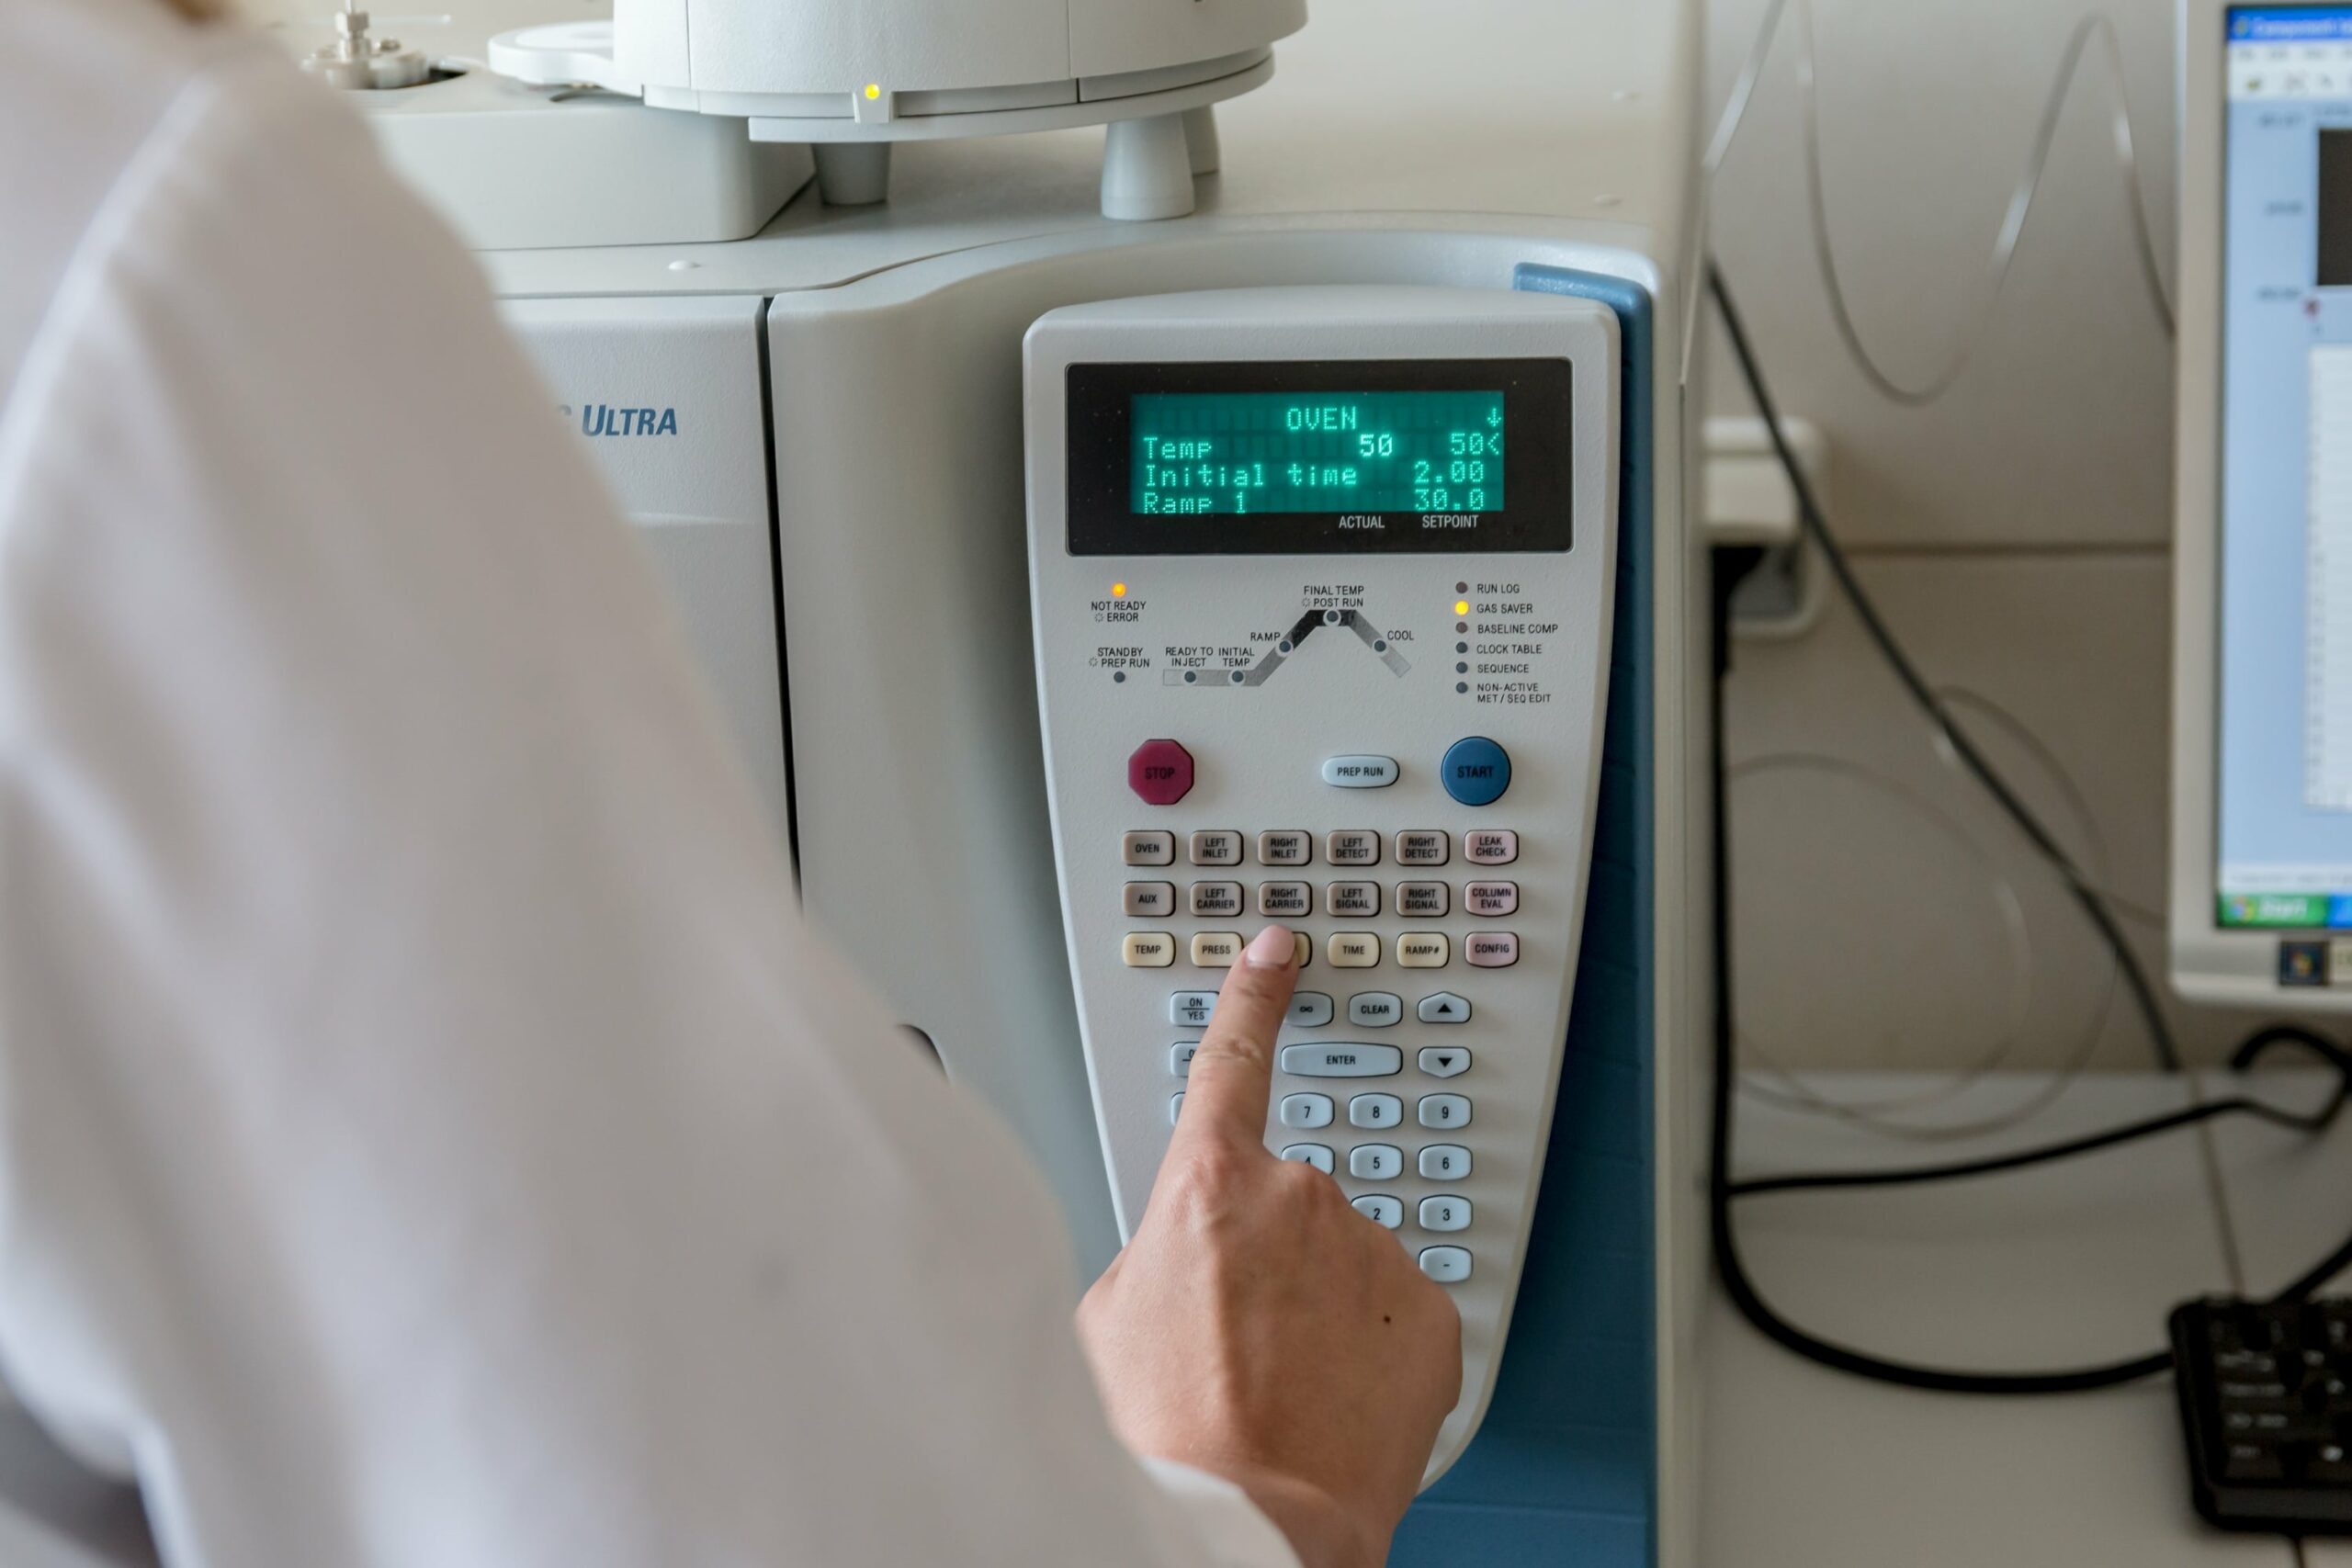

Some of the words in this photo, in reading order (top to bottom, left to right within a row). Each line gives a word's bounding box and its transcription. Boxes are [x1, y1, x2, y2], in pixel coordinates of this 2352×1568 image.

[1287, 407, 1356, 430] OVEN
[1143, 436, 1212, 459] Temp
[1361, 434, 1392, 457] 50
[1146, 464, 1263, 487] Initial
[1287, 463, 1357, 487] time
[1415, 460, 1483, 483] 2.00
[1144, 491, 1212, 513] Ramp
[1237, 491, 1246, 513] 1
[1415, 489, 1483, 511] 30.0
[1339, 515, 1385, 528] ACTUAL
[1422, 514, 1478, 528] SETPOINT
[1304, 586, 1333, 595] FINAL
[1336, 586, 1364, 595] TEMP
[1477, 584, 1498, 593] RUN
[1501, 584, 1520, 593] LOG
[1091, 602, 1111, 611] NOT
[1114, 601, 1147, 610] READY
[1314, 599, 1339, 607] POST
[1342, 598, 1363, 606] RUN
[1477, 604, 1498, 614] GAS
[1501, 604, 1533, 614] SAVER
[1107, 613, 1139, 622] ERROR
[1477, 625, 1525, 634] BASELINE
[1528, 625, 1558, 634] COMP
[1250, 632, 1281, 641] RAMP
[1387, 630, 1414, 640] COOL
[1098, 647, 1144, 657] STANDBY
[1165, 647, 1198, 656] READY
[1201, 647, 1214, 656] TO
[1218, 647, 1255, 656] INITIAL
[1476, 644, 1509, 654] CLOCK
[1511, 644, 1542, 654] TABLE
[1102, 658, 1126, 668] PREP
[1129, 658, 1150, 668] RUN
[1171, 658, 1206, 667] INJECT
[1223, 658, 1250, 667] TEMP
[1477, 663, 1529, 673] SEQUENCE
[1477, 683, 1538, 692] NON-ACTIVE
[1477, 694, 1498, 704] MET
[1507, 694, 1526, 704] SEQ
[1529, 694, 1551, 703] EDIT
[1144, 767, 1175, 779] STOP
[1337, 766, 1361, 777] PREP
[1363, 766, 1384, 777] RUN
[1457, 766, 1494, 778] START
[1205, 838, 1226, 847] LEFT
[1270, 838, 1297, 847] RIGHT
[1342, 838, 1363, 847] LEFT
[1408, 838, 1436, 847] RIGHT
[1478, 837, 1503, 846] LEAK
[1135, 843, 1159, 854] OVEN
[1202, 848, 1228, 858] INLET
[1272, 848, 1297, 858] INLET
[1336, 848, 1369, 858] DETECT
[1405, 848, 1439, 858] DETECT
[1476, 847, 1507, 856] CHECK
[1205, 889, 1226, 898] LEFT
[1270, 889, 1297, 898] RIGHT
[1342, 889, 1363, 898] LEFT
[1408, 889, 1436, 898] RIGHT
[1472, 887, 1511, 898] COLUMN
[1138, 895, 1158, 904] AUX
[1196, 898, 1235, 909] CARRIER
[1264, 898, 1304, 909] CARRIER
[1335, 898, 1370, 909] SIGNAL
[1405, 899, 1439, 909] SIGNAL
[1480, 898, 1503, 908] EVAL
[1135, 944, 1161, 955] TEMP
[1202, 944, 1231, 955] PRESS
[1342, 945, 1365, 955] TIME
[1406, 945, 1440, 955] RAMP#
[1475, 943, 1510, 953] CONFIG
[1189, 998, 1203, 1007] ON
[1361, 1005, 1390, 1014] CLEAR
[1188, 1010, 1205, 1020] YES
[1327, 1055, 1356, 1065] ENTER
[1305, 1106, 1310, 1119] 7
[1373, 1106, 1380, 1119] 8
[1442, 1106, 1449, 1119] 9
[1373, 1156, 1380, 1169] 5
[1442, 1157, 1450, 1170] 6
[1373, 1207, 1381, 1221] 2
[1442, 1209, 1450, 1222] 3
